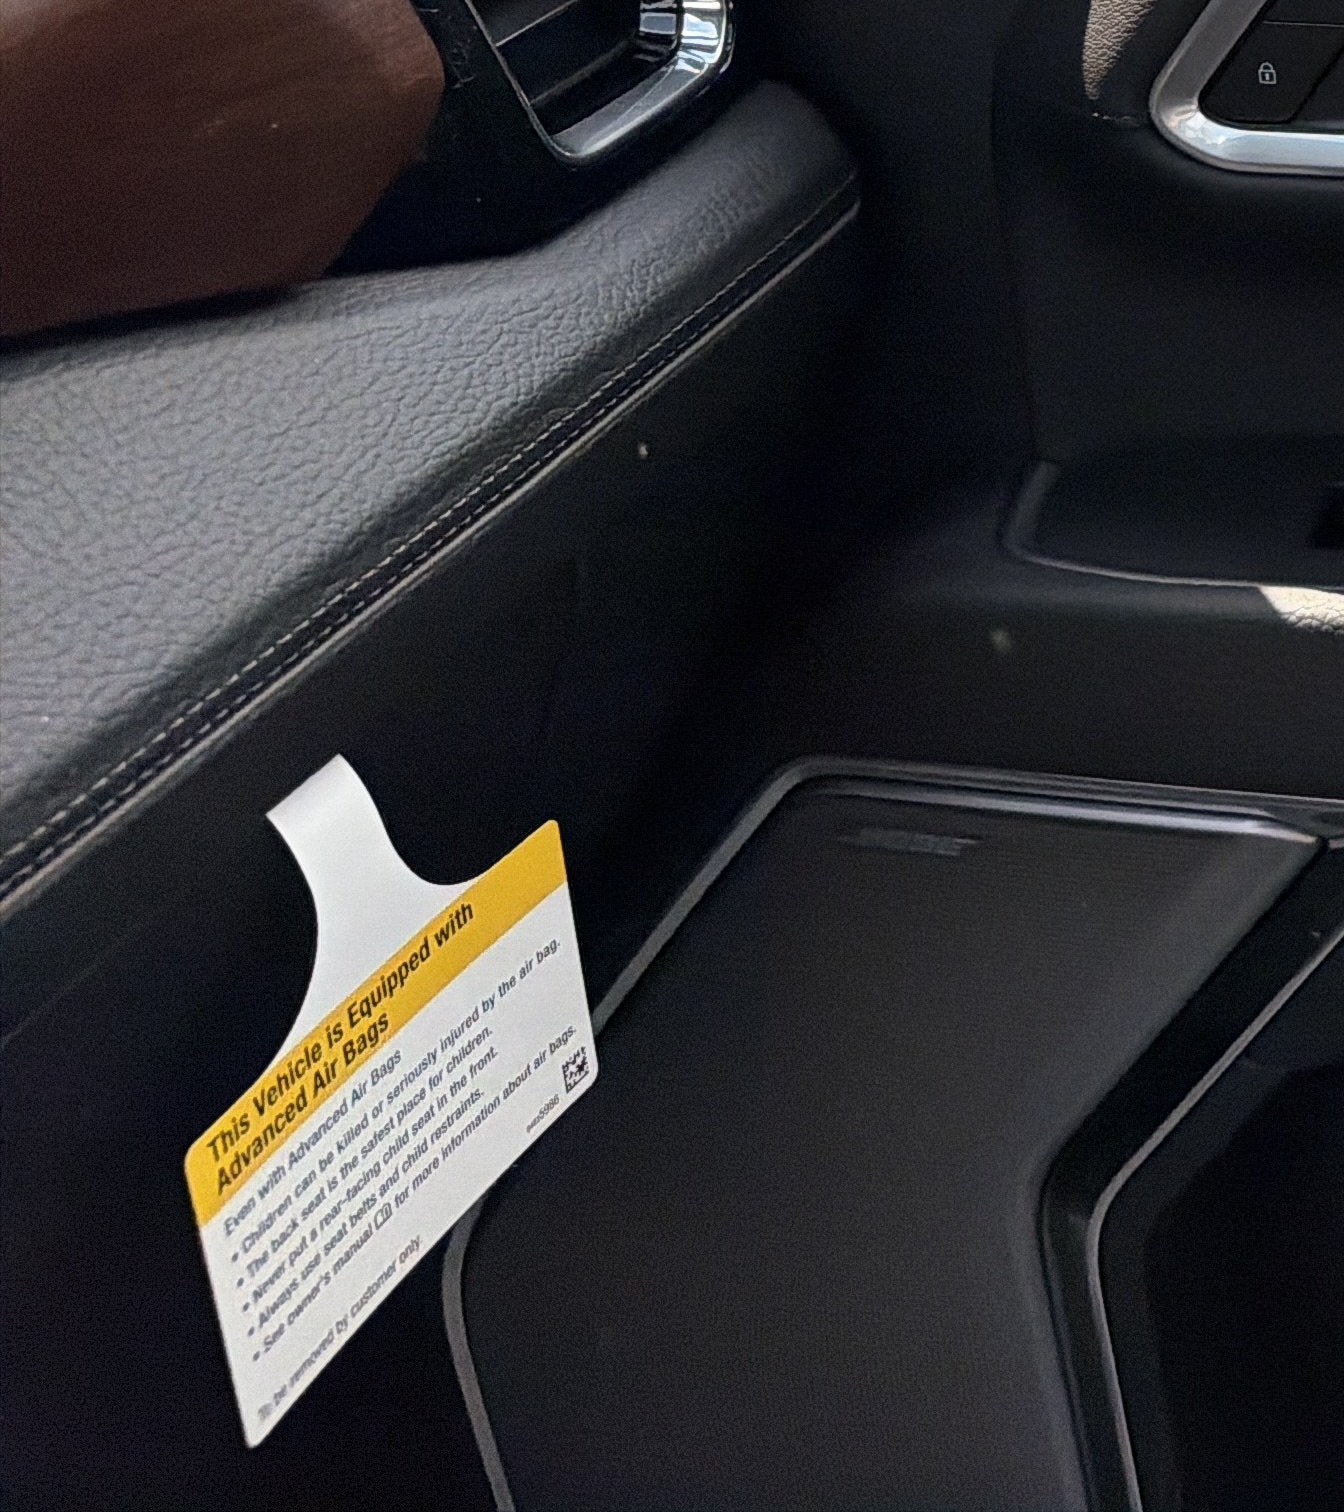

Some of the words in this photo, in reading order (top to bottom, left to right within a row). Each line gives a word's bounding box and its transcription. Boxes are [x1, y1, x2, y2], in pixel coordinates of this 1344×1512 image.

[206, 1112, 250, 1163] This
[253, 1042, 323, 1117] Vehicle
[325, 1024, 345, 1049] is
[347, 937, 431, 1028] Equipped
[434, 902, 475, 949] with
[217, 1092, 308, 1196] Advanced
[313, 1058, 339, 1099] Air
[343, 1011, 390, 1068] Bags
[224, 1197, 256, 1236] Even
[257, 1164, 286, 1200] with
[288, 1098, 349, 1170] Advanced
[350, 1081, 368, 1107] Air
[370, 1049, 402, 1086] Bags
[242, 1194, 292, 1254] Children
[294, 1169, 317, 1199] can
[318, 1150, 335, 1174] be
[336, 1113, 369, 1154] killed
[371, 1100, 384, 1120] or
[386, 1047, 437, 1105] seriously
[440, 1006, 480, 1054] injured
[481, 992, 495, 1015] by
[498, 975, 517, 998] the
[519, 959, 533, 980] air
[535, 938, 560, 963] bag.
[247, 1250, 269, 1278] The
[270, 1218, 299, 1254] back
[300, 1186, 327, 1221] seat
[327, 1175, 339, 1193] is
[340, 1155, 359, 1180] the
[360, 1117, 396, 1160] safest
[396, 1088, 426, 1125] place
[429, 1070, 444, 1092] for
[446, 1026, 493, 1075] children.
[252, 1261, 286, 1303] Never
[289, 1235, 309, 1267] put
[319, 1162, 381, 1231] rear-facing
[382, 1128, 409, 1166] child
[411, 1105, 438, 1137] seat
[437, 1093, 448, 1112] in
[449, 1075, 468, 1097] the
[469, 1046, 499, 1076] front.
[258, 1278, 300, 1329] Always
[300, 1253, 321, 1280] use
[323, 1222, 349, 1257] seat
[349, 1193, 378, 1228] belts
[379, 1168, 400, 1198] and
[401, 1137, 429, 1173] child
[430, 1087, 485, 1145] restraints.
[263, 1323, 285, 1352] See
[286, 1271, 332, 1327] owner's
[332, 1223, 374, 1275] manual
[394, 1186, 410, 1209] for
[412, 1157, 440, 1191] more
[441, 1097, 501, 1161] information
[502, 1064, 532, 1101] about
[533, 1049, 547, 1071] air
[549, 1025, 577, 1056] bags.
[288, 1328, 335, 1387] removed
[350, 1258, 397, 1319] customer
